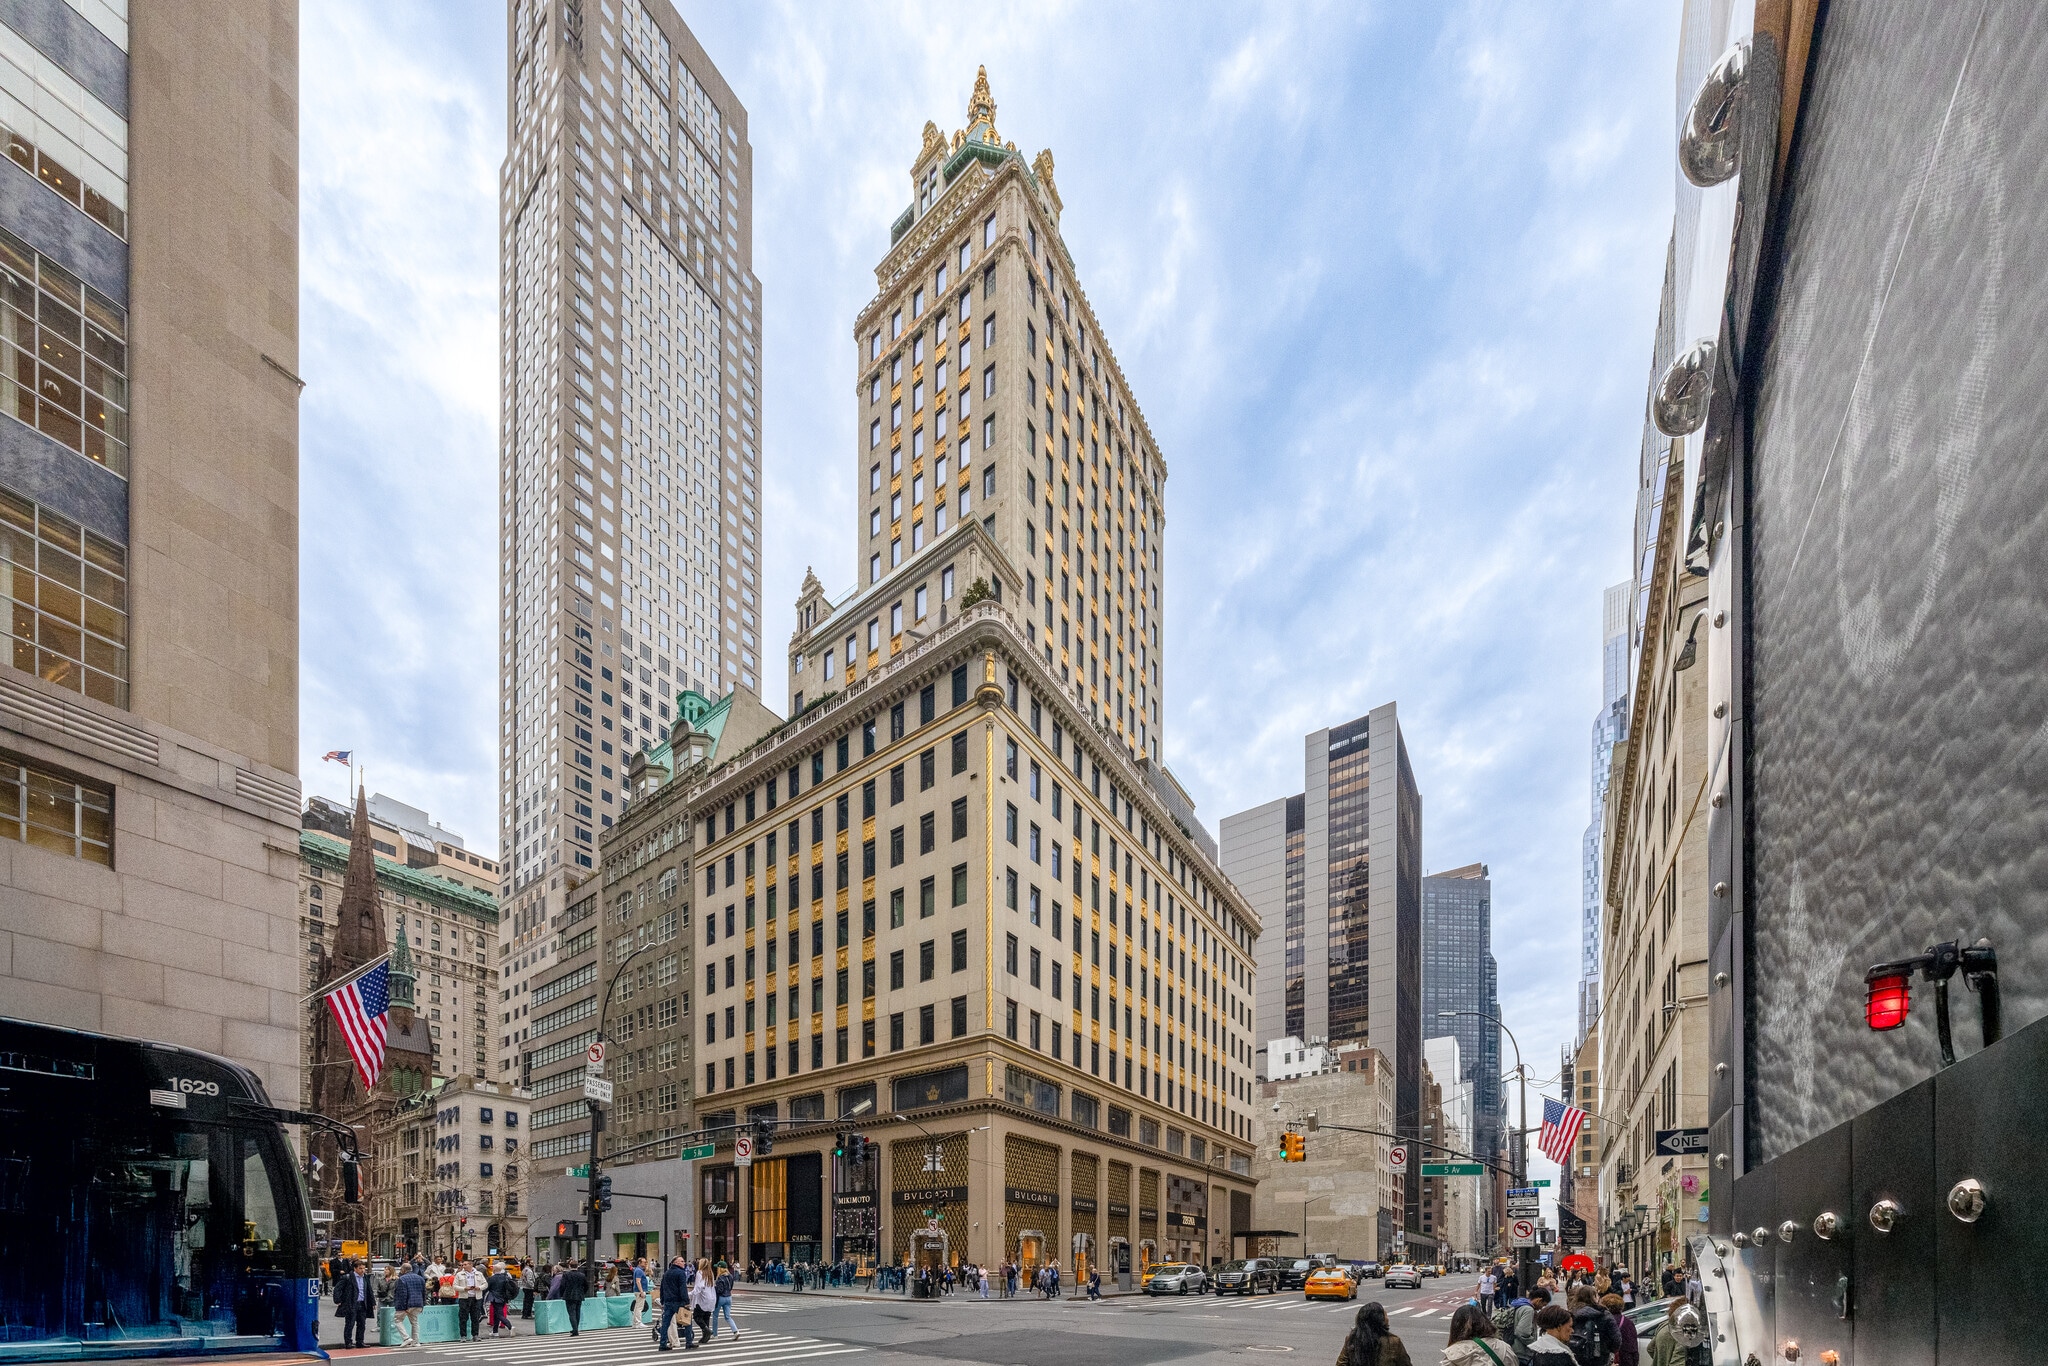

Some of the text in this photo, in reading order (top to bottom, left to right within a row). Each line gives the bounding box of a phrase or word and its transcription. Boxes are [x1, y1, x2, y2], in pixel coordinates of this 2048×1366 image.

[168, 1077, 219, 1096] 1629
[587, 1078, 610, 1090] PASSENGER
[586, 1086, 610, 1098] CARS ONLY
[1672, 1136, 1699, 1147] ONE
[838, 1196, 870, 1204] MIKIMOTO
[1014, 1191, 1052, 1203] BVLGARI
[708, 1204, 728, 1216] Chopard
